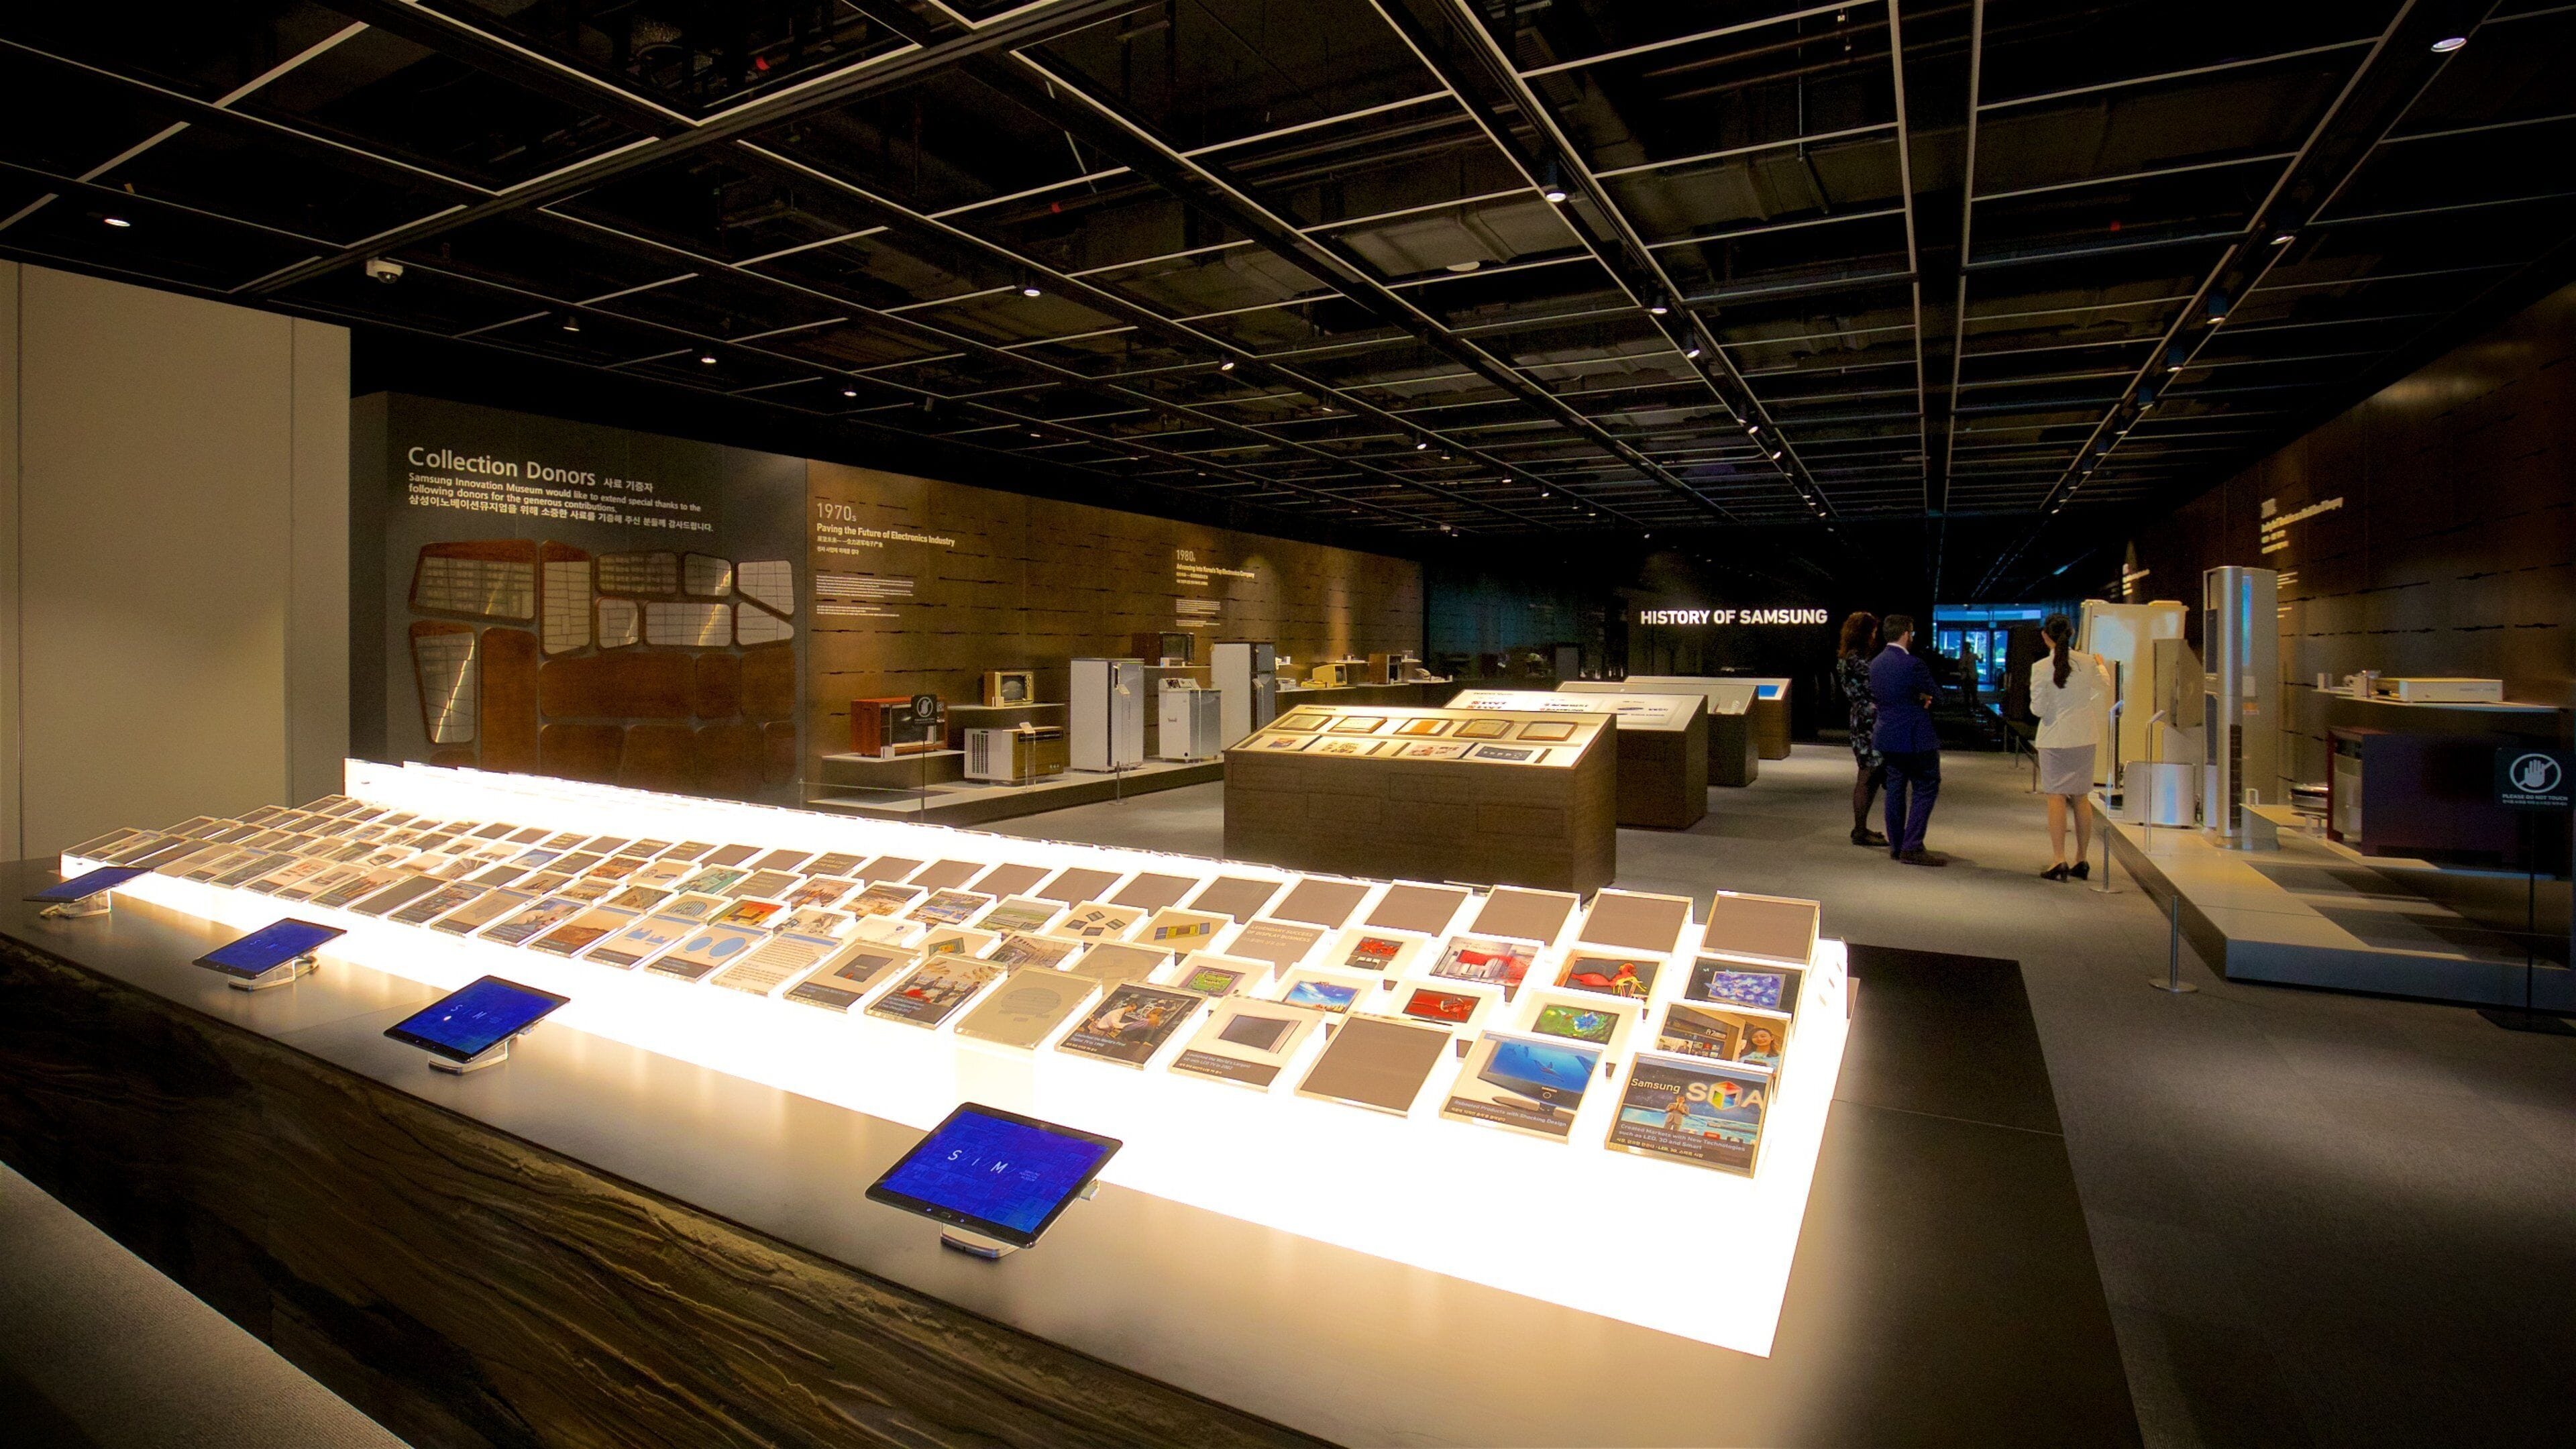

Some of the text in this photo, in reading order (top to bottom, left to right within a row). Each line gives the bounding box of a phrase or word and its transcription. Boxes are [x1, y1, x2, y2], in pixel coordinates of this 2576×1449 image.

[408, 447, 596, 486] Collection Donors
[409, 472, 452, 486] Samsung
[455, 478, 503, 490] Innovation
[506, 483, 543, 494] Museum
[545, 488, 571, 498] would
[574, 490, 588, 499] like
[600, 494, 626, 504] extend
[629, 498, 653, 506] special
[655, 500, 678, 509] thanks
[690, 504, 701, 512] the
[603, 478, 653, 493] 사료 기증자
[409, 484, 617, 513] following donors for the generous contributions.
[409, 494, 714, 532] 삼성이노베이션뮤지엄을 위해 소중한 사료를 기증해 주신 분들께 감사드립니다.
[816, 502, 857, 522] 1970s
[816, 523, 955, 547] Paving the Future of Electronics Industry
[1640, 608, 1828, 625] HISTORY OF SAMSUNG
[1631, 1077, 1681, 1095] Samsung
[1481, 1105, 1505, 1114] Products
[1519, 1113, 1546, 1123] Shocking
[1546, 1118, 1566, 1127] Design
[1621, 1124, 1644, 1132] Created
[1646, 1128, 1671, 1137] Markets
[1703, 1138, 1746, 1152] Technologies
[1682, 1142, 1702, 1150] Smart
